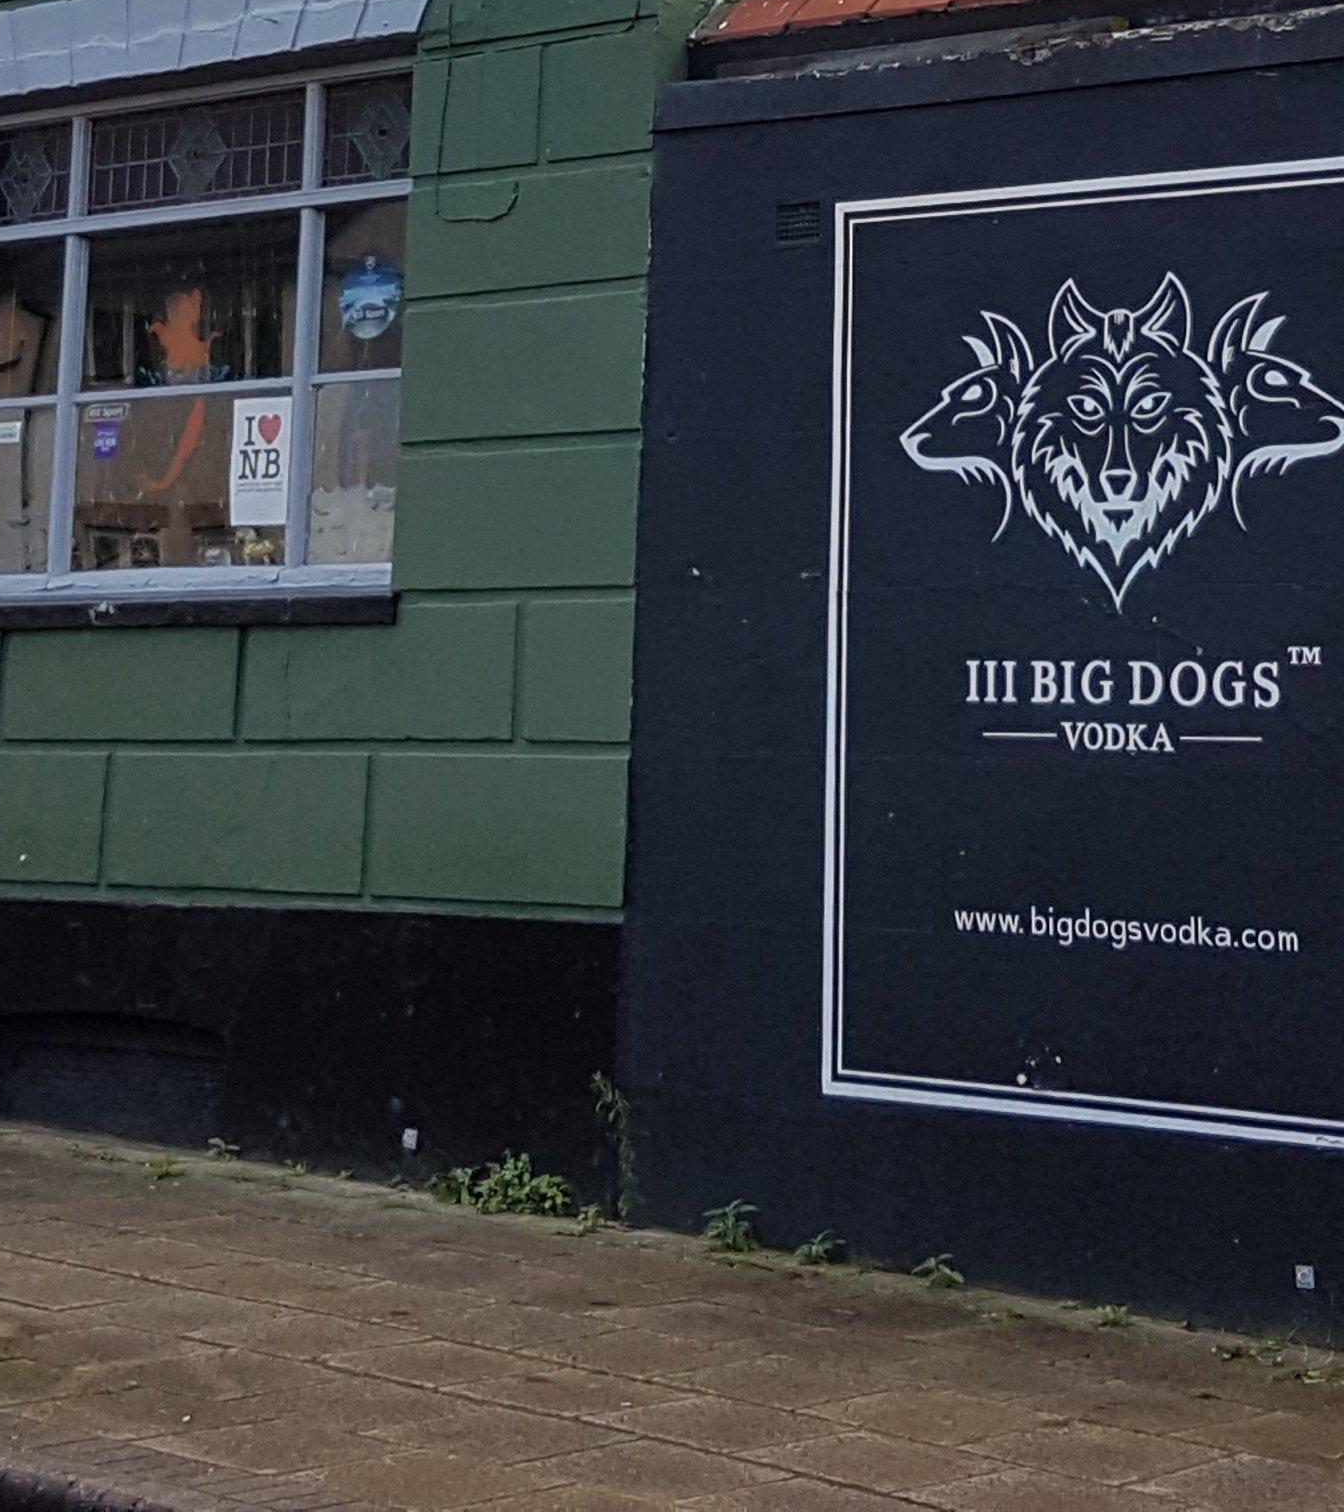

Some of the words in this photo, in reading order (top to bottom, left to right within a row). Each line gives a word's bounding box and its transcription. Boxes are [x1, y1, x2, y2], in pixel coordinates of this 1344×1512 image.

[244, 415, 256, 446] I
[238, 448, 281, 480] NB
[965, 659, 1018, 703] III
[1030, 659, 1115, 705] BIG
[1127, 660, 1282, 709] DOGS
[1060, 721, 1176, 753] VODKA
